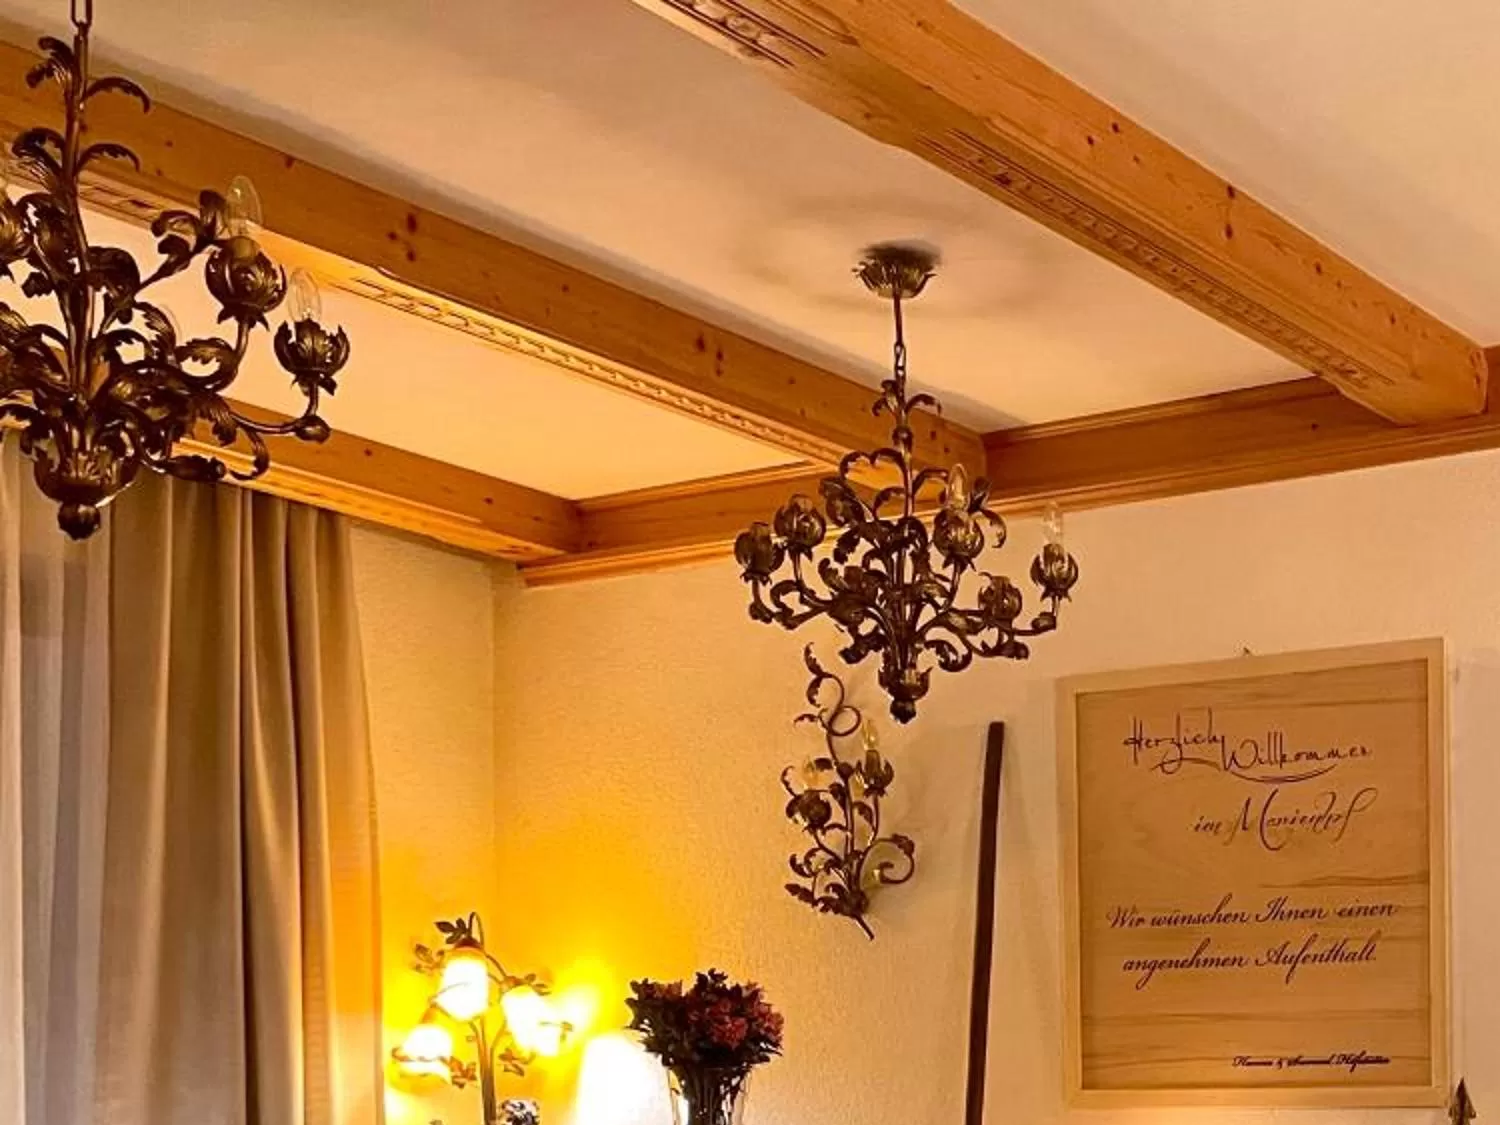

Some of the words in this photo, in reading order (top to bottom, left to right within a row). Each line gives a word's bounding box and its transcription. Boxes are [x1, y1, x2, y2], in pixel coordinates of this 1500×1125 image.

[1122, 706, 1222, 775] Herzlich
[1220, 730, 1373, 783] Willkommen
[1107, 904, 1147, 929] Wir
[1150, 892, 1250, 927] wünschen
[1254, 895, 1329, 923] Ihnen
[1334, 898, 1399, 919] einen
[1121, 936, 1249, 991] angenehmen
